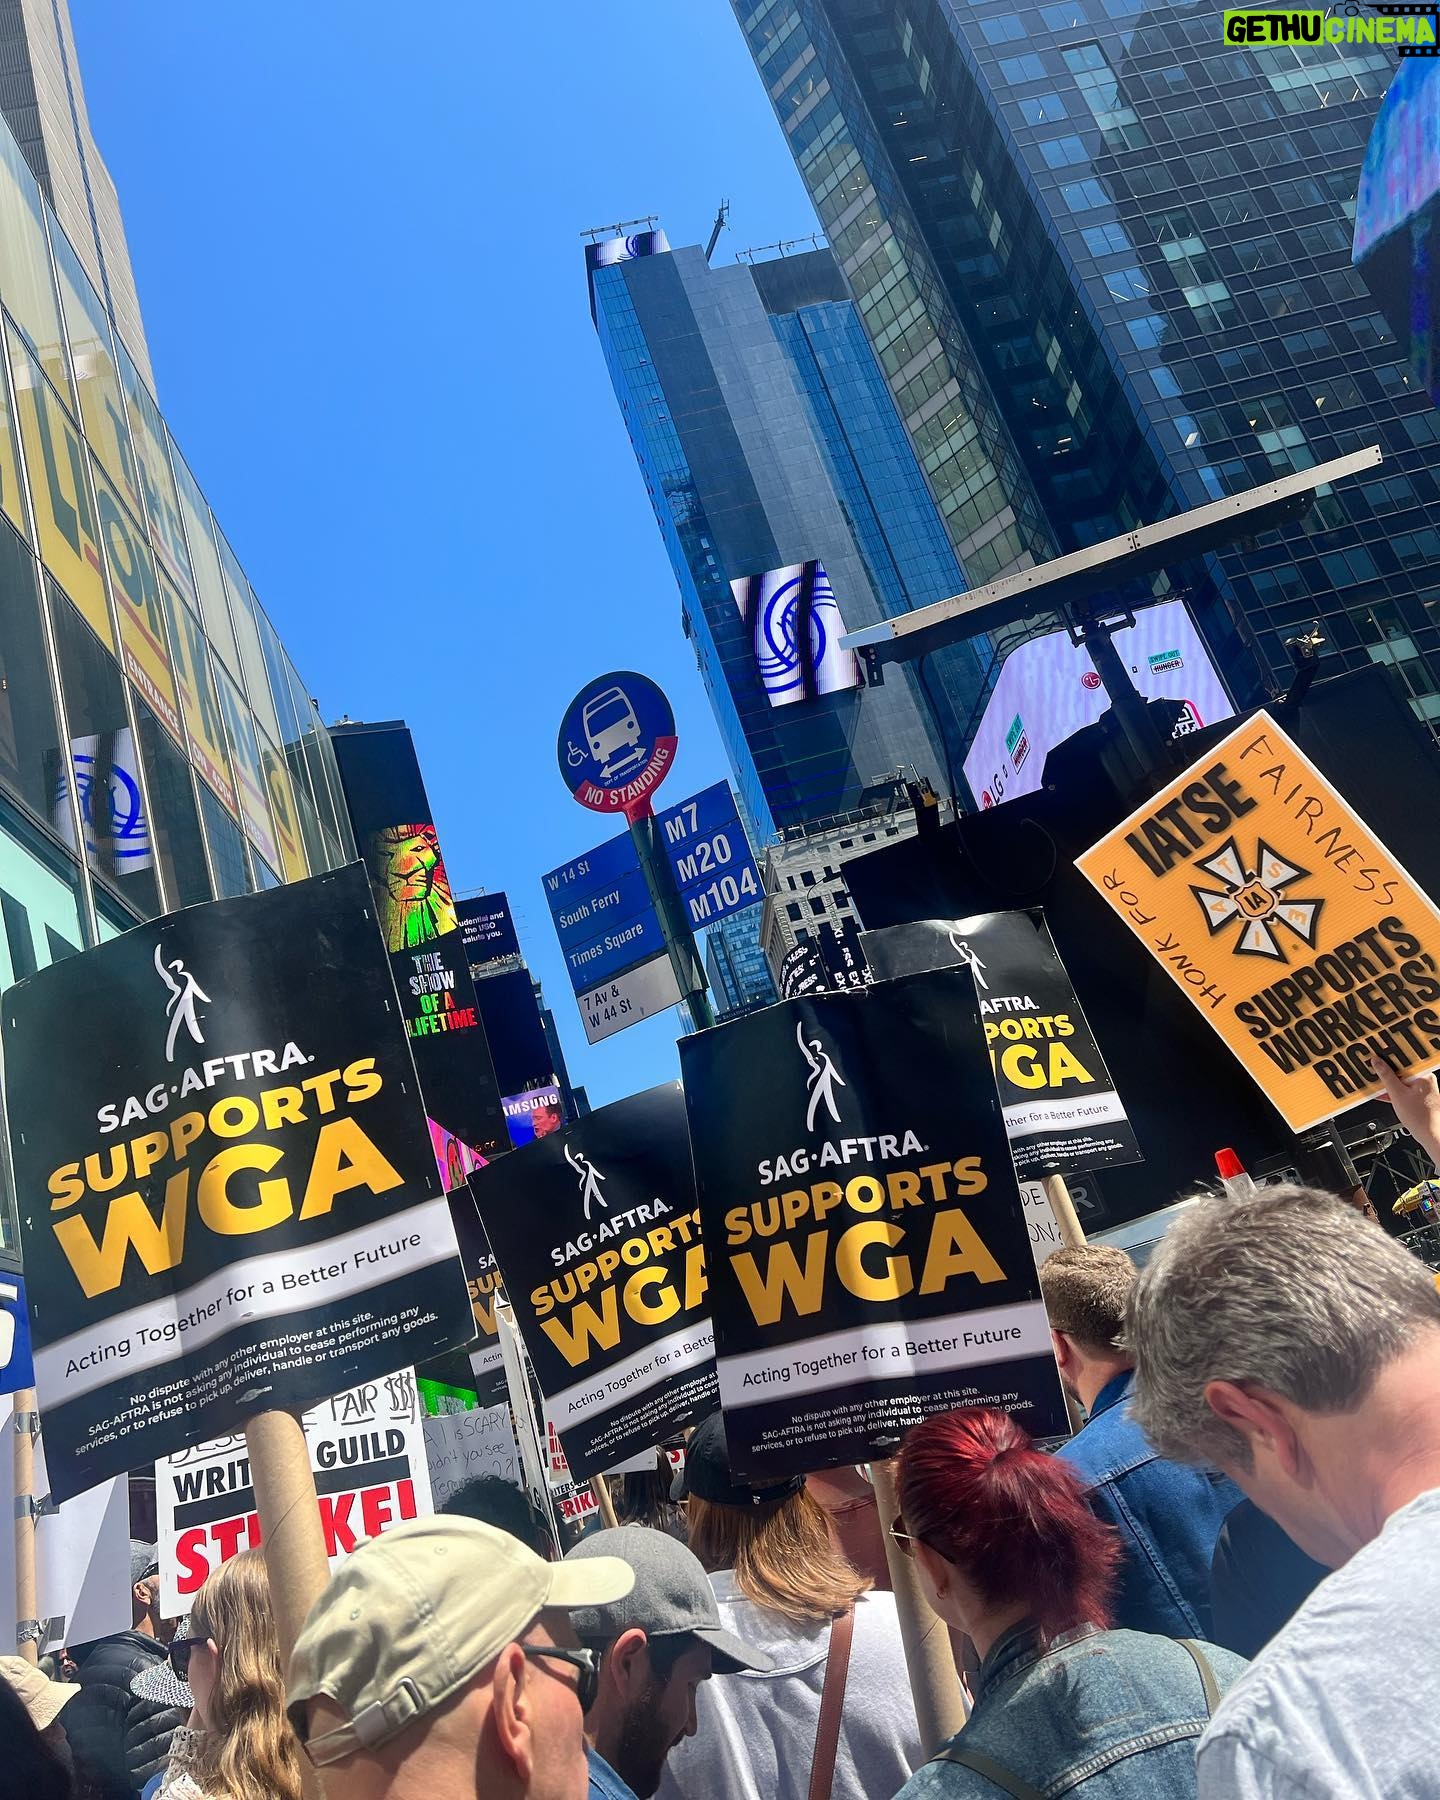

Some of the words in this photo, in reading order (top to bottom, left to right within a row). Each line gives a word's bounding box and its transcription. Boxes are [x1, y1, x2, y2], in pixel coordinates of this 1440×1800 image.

[1153, 660, 1180, 672] HUNGER
[584, 787, 604, 805] NO
[609, 747, 670, 805] STANDING
[664, 803, 698, 844] M7
[1124, 763, 1258, 878] IATSE
[1239, 734, 1399, 906] FAIRNESS
[547, 878, 560, 892] W
[562, 868, 577, 885] 14
[578, 860, 590, 876] St
[677, 834, 731, 883] M20
[459, 914, 489, 928] udential
[490, 911, 505, 921] and
[559, 904, 590, 929] South
[592, 890, 621, 914] Ferry
[689, 868, 757, 922] M104
[1102, 867, 1157, 927] FOR
[462, 933, 486, 945] salute
[486, 930, 503, 942] you.
[465, 926, 477, 936] the
[479, 921, 496, 933] USO
[570, 943, 604, 969] Times
[604, 922, 644, 952] Square
[409, 970, 455, 995] SHOW
[412, 952, 444, 973] THE
[1154, 931, 1228, 1010] HONK
[1234, 915, 1422, 1040] SUPPORTS
[420, 992, 439, 1014] OF
[444, 991, 456, 1009] A
[583, 997, 592, 1012] 7
[592, 990, 609, 1007] Av
[611, 983, 621, 997] &
[588, 1013, 602, 1029] W
[602, 1005, 619, 1022] 44
[621, 998, 632, 1014] St
[405, 1008, 478, 1038] LIFETIME
[983, 1014, 1075, 1046] PORTS
[989, 1041, 1095, 1090] GA
[1312, 1008, 1440, 1100] RIGHTS
[48, 1058, 383, 1211] SUPPORTS
[1029, 1112, 1042, 1122] for
[1050, 1110, 1075, 1119] Better
[1077, 1104, 1109, 1115] Future
[52, 1117, 405, 1298] WGA
[724, 1156, 988, 1246] SUPPORTS
[729, 1208, 1007, 1328] WGA
[66, 1338, 131, 1378] Acting
[136, 1296, 223, 1346] Together
[226, 1281, 255, 1306] for
[262, 1278, 275, 1295] a
[281, 1259, 348, 1291] Better
[353, 1231, 422, 1273] Future
[539, 1243, 709, 1368] WGA
[88, 1404, 151, 1436] SAG-AFTRA
[152, 1400, 162, 1411] is
[163, 1391, 184, 1406] not
[185, 1378, 217, 1398] asking
[218, 1367, 234, 1383] any
[234, 1347, 287, 1373] individual
[290, 1345, 302, 1355] to
[304, 1337, 336, 1352] cease
[338, 1313, 398, 1346] performing
[399, 1305, 420, 1320] any
[130, 1394, 147, 1406] No
[148, 1377, 190, 1400] dispute
[192, 1367, 213, 1382] with
[214, 1357, 229, 1371] any
[230, 1344, 257, 1362] other
[261, 1330, 314, 1351] employer
[316, 1327, 329, 1337] at
[330, 1317, 351, 1333] this
[352, 1310, 374, 1325] site.
[567, 1390, 605, 1414] Acting
[604, 1361, 654, 1394] Together
[654, 1353, 671, 1369] for
[674, 1348, 682, 1360] a
[683, 1333, 716, 1354] Bette
[743, 1366, 791, 1387] Acting
[793, 1347, 858, 1378] Together
[861, 1343, 887, 1360] for
[890, 1343, 901, 1357] a
[906, 1334, 959, 1357] Better
[963, 1323, 1022, 1348] Future
[75, 1431, 118, 1456] services,
[120, 1425, 131, 1436] or
[133, 1417, 146, 1430] to
[148, 1404, 183, 1426] refuse
[185, 1400, 197, 1411] to
[199, 1389, 218, 1408] pick
[220, 1382, 234, 1398] up,
[234, 1365, 271, 1387] deliver,
[272, 1354, 313, 1373] handle
[315, 1352, 327, 1362] or
[329, 1335, 380, 1358] transport
[382, 1326, 401, 1343] any
[402, 1310, 439, 1333] goods.
[791, 1414, 803, 1424] No
[803, 1409, 831, 1422] dispute
[832, 1405, 849, 1417] with
[849, 1402, 864, 1415] any
[864, 1397, 888, 1410] other
[889, 1393, 931, 1407] employer
[933, 1391, 942, 1400] at
[943, 1388, 961, 1398] this
[962, 1385, 981, 1396] site.
[454, 1429, 463, 1440] is
[464, 1407, 506, 1437] SCARY
[762, 1423, 806, 1441] SAG-AFTRA
[807, 1422, 813, 1432] is
[814, 1419, 828, 1430] not
[828, 1413, 852, 1428] asking
[852, 1411, 867, 1425] any
[868, 1405, 911, 1419] individual
[912, 1404, 922, 1414] to
[923, 1402, 949, 1413] cease
[950, 1393, 1001, 1410] performing
[1002, 1391, 1019, 1402] any
[316, 1428, 406, 1469] GUILD
[463, 1449, 483, 1469] you
[485, 1443, 508, 1456] see
